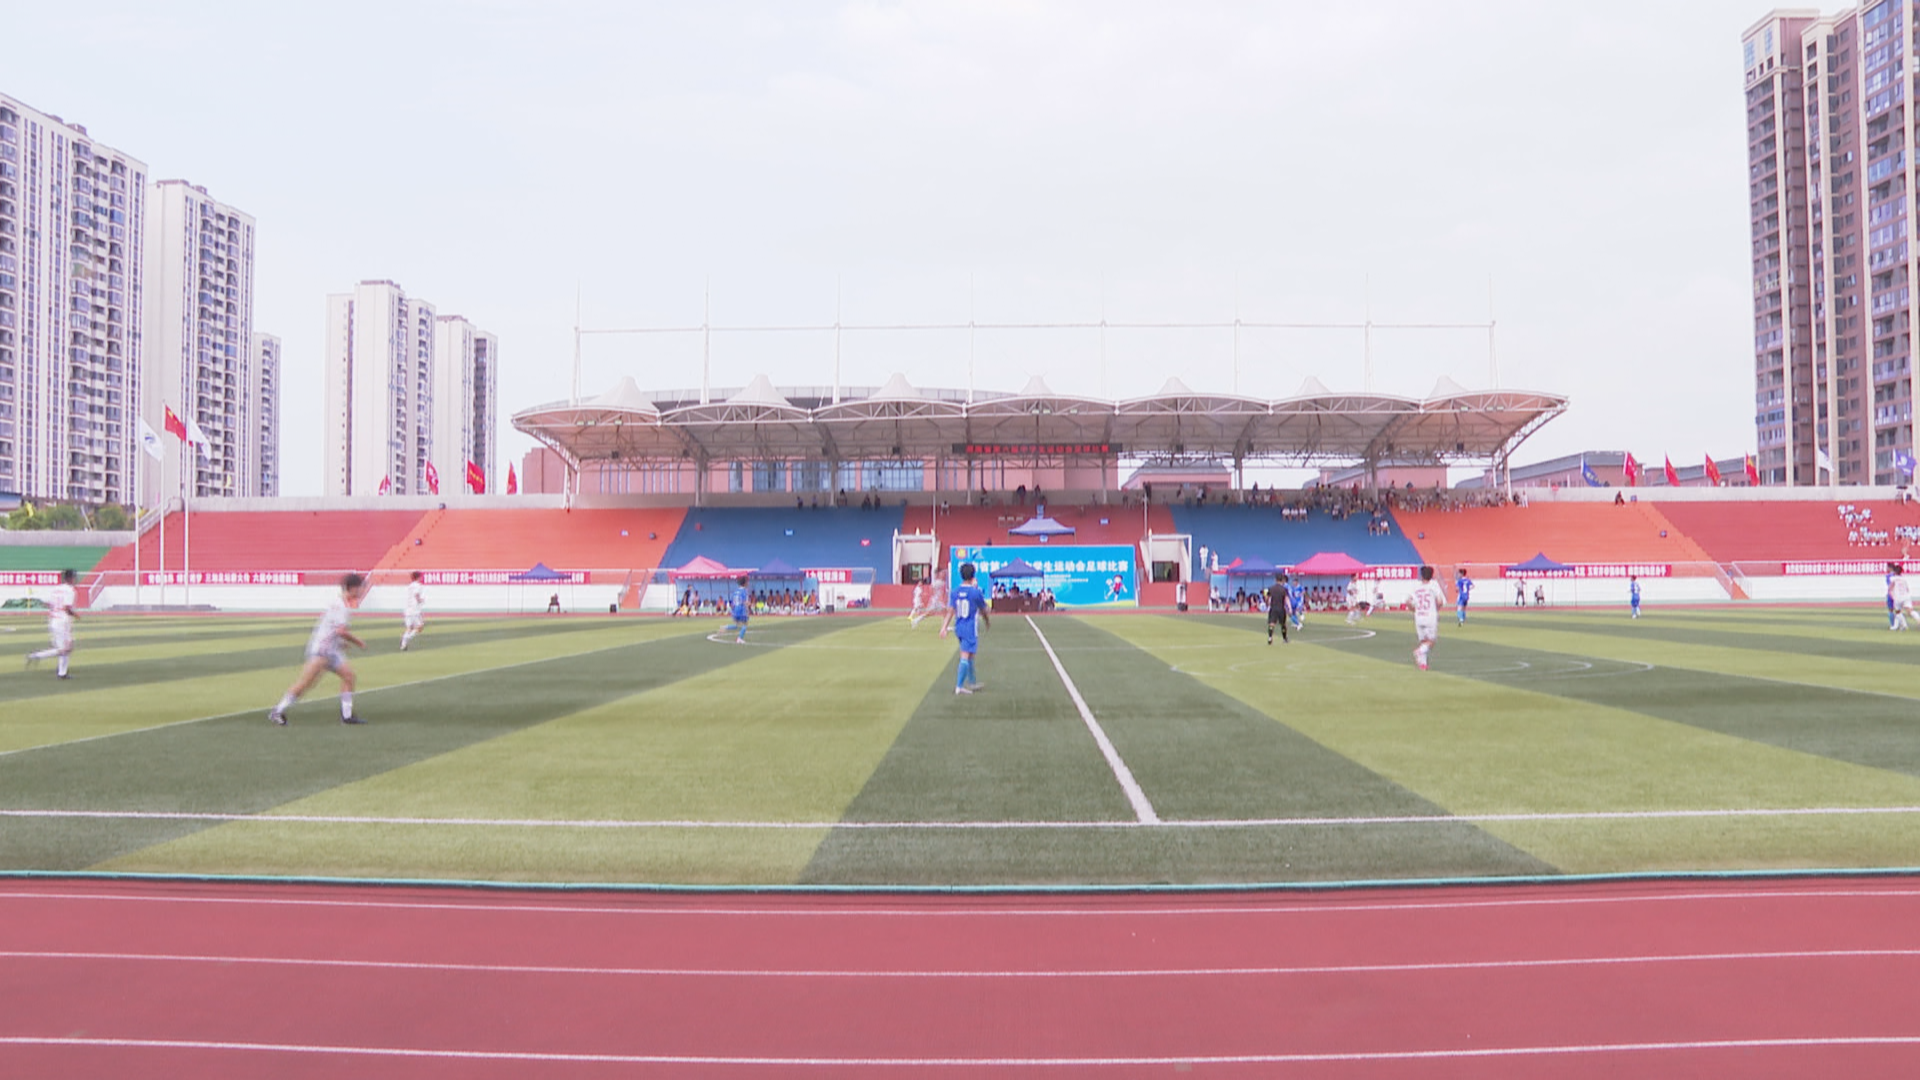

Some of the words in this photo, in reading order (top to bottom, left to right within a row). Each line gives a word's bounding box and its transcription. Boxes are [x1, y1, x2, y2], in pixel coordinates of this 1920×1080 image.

[958, 560, 1128, 573] 省第学生运动会足球比赛
[955, 598, 969, 619] 10
[1417, 593, 1431, 611] 35
